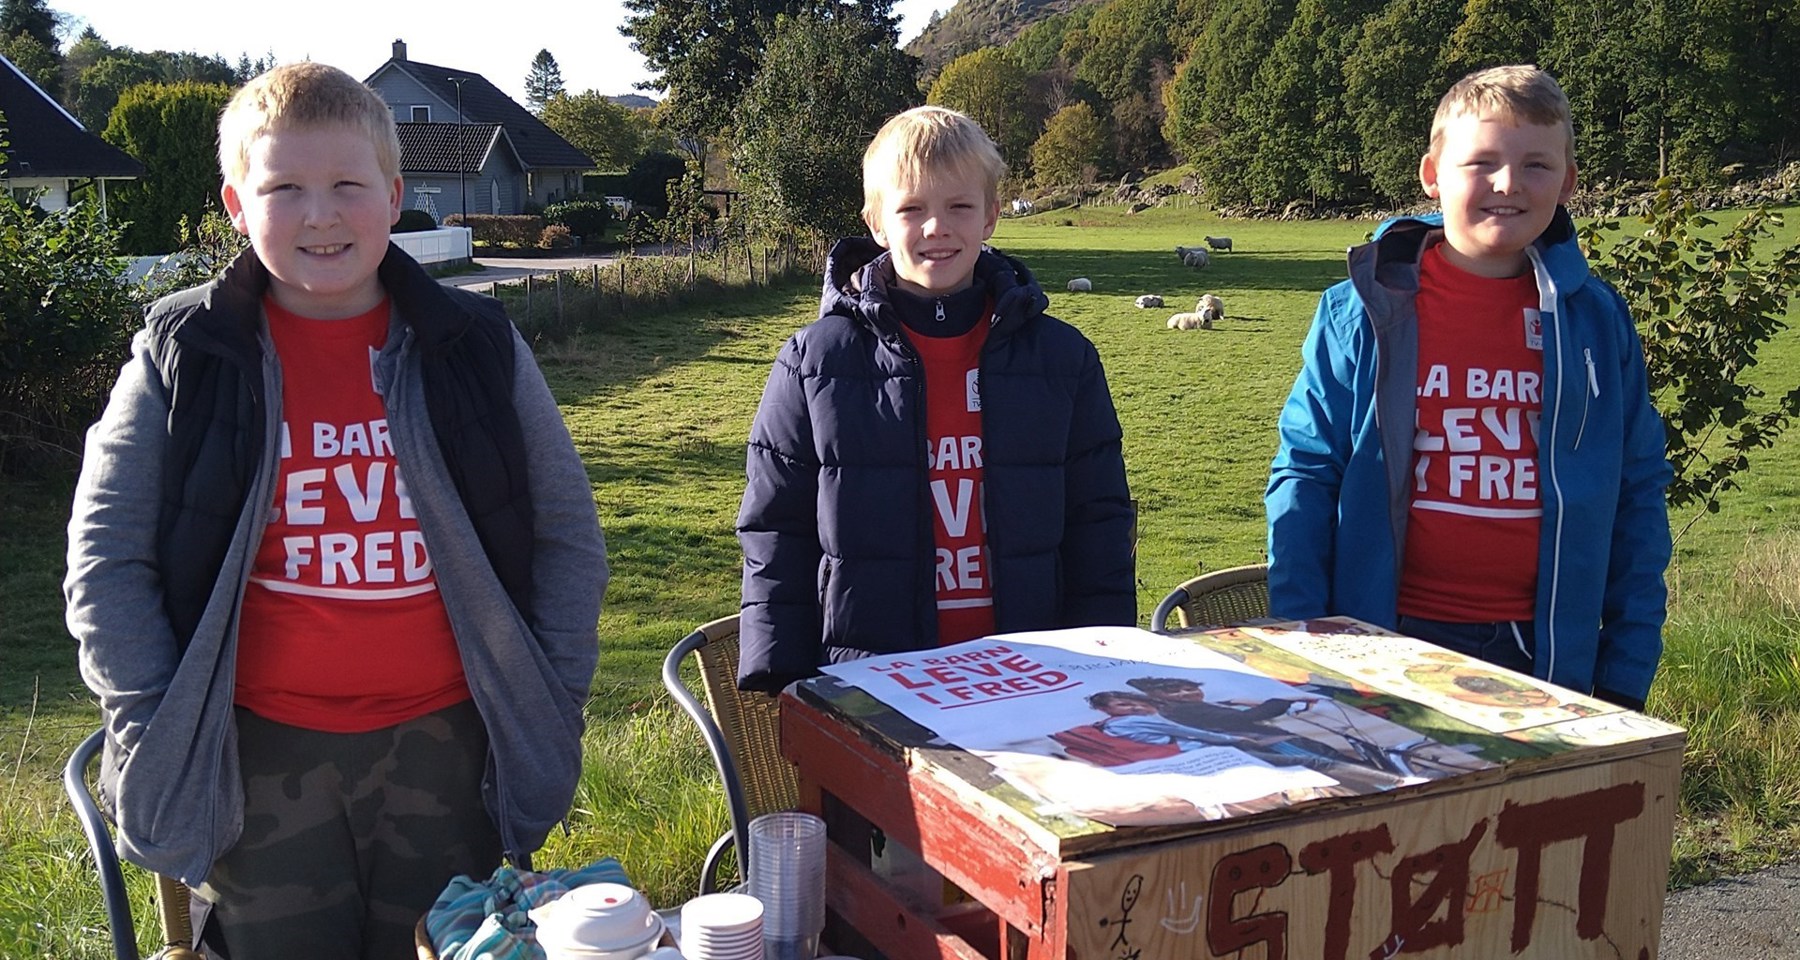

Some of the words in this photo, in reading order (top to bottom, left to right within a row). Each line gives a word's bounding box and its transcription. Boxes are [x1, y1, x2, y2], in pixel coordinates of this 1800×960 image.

[1417, 365, 1449, 397] A
[1466, 368, 1544, 403] BAR
[313, 418, 395, 458] BAR
[927, 436, 983, 470] AR
[268, 461, 416, 525] EV
[1449, 455, 1538, 500] FRE
[283, 531, 433, 585] FRED
[936, 545, 993, 591] RE
[869, 661, 915, 672] LA
[921, 646, 1013, 666] BARN
[887, 654, 1043, 689] LEVE
[916, 692, 942, 704] I
[945, 670, 1068, 700] FRED
[1206, 781, 1645, 960] STØTT
